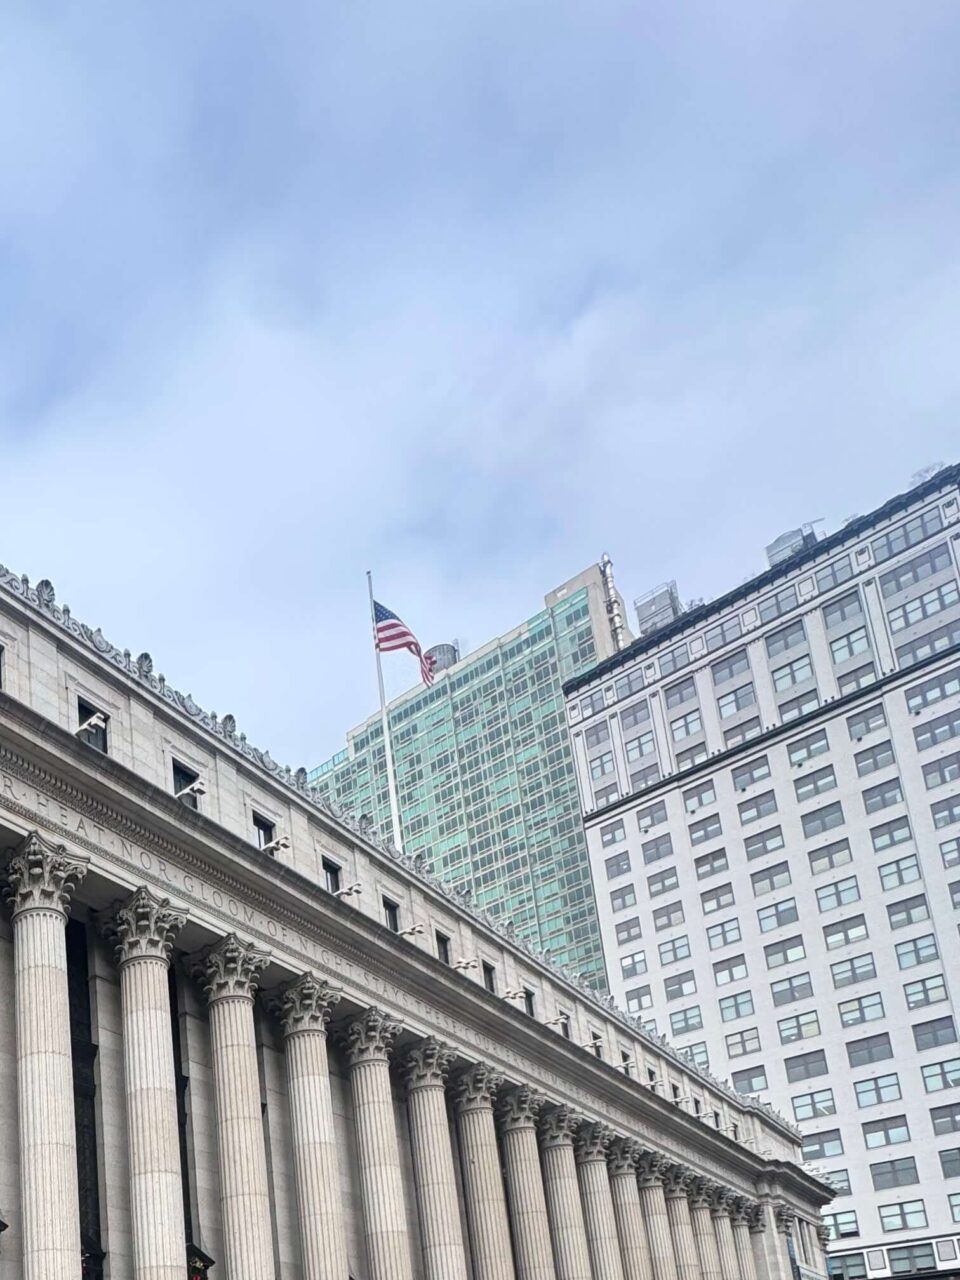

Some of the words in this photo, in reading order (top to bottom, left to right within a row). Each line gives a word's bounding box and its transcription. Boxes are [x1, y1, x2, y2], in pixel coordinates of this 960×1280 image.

[36, 793, 106, 845] HEAT
[120, 838, 172, 882] NOR
[183, 876, 256, 923] GLOOM
[267, 921, 288, 943] OF
[298, 936, 353, 977] NIGHT
[363, 971, 409, 1007] STAYS
